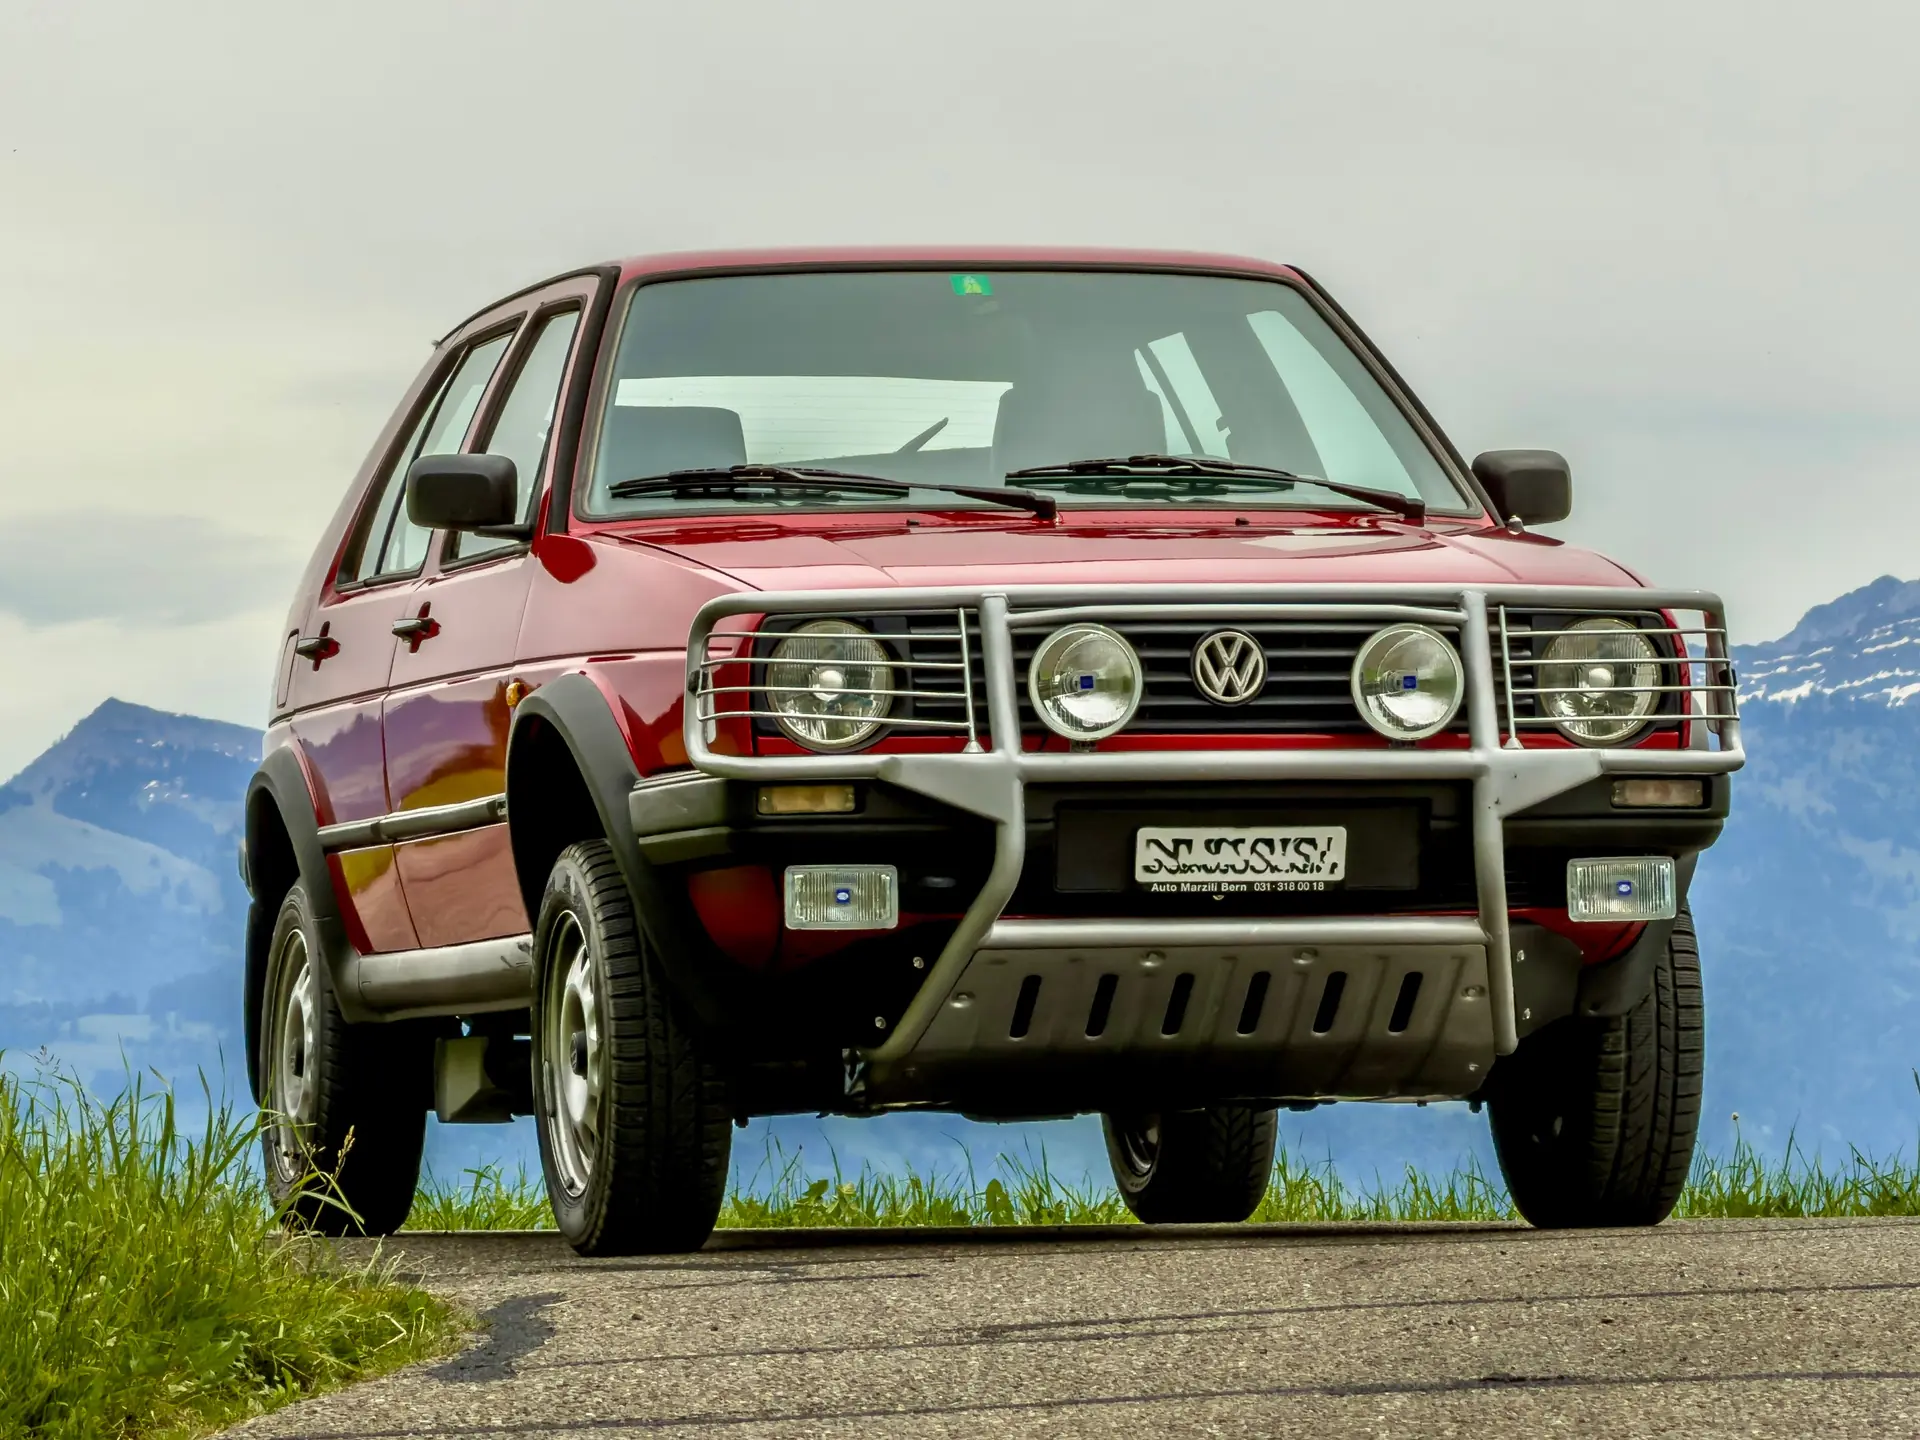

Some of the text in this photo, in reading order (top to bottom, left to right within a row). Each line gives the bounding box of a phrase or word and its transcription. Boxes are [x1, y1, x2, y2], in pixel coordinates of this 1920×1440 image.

[1195, 632, 1264, 702] VW
[1150, 882, 1178, 893] Auto
[1221, 882, 1247, 893] Bern
[1297, 881, 1310, 892] 00
[1312, 881, 1325, 892] 18
